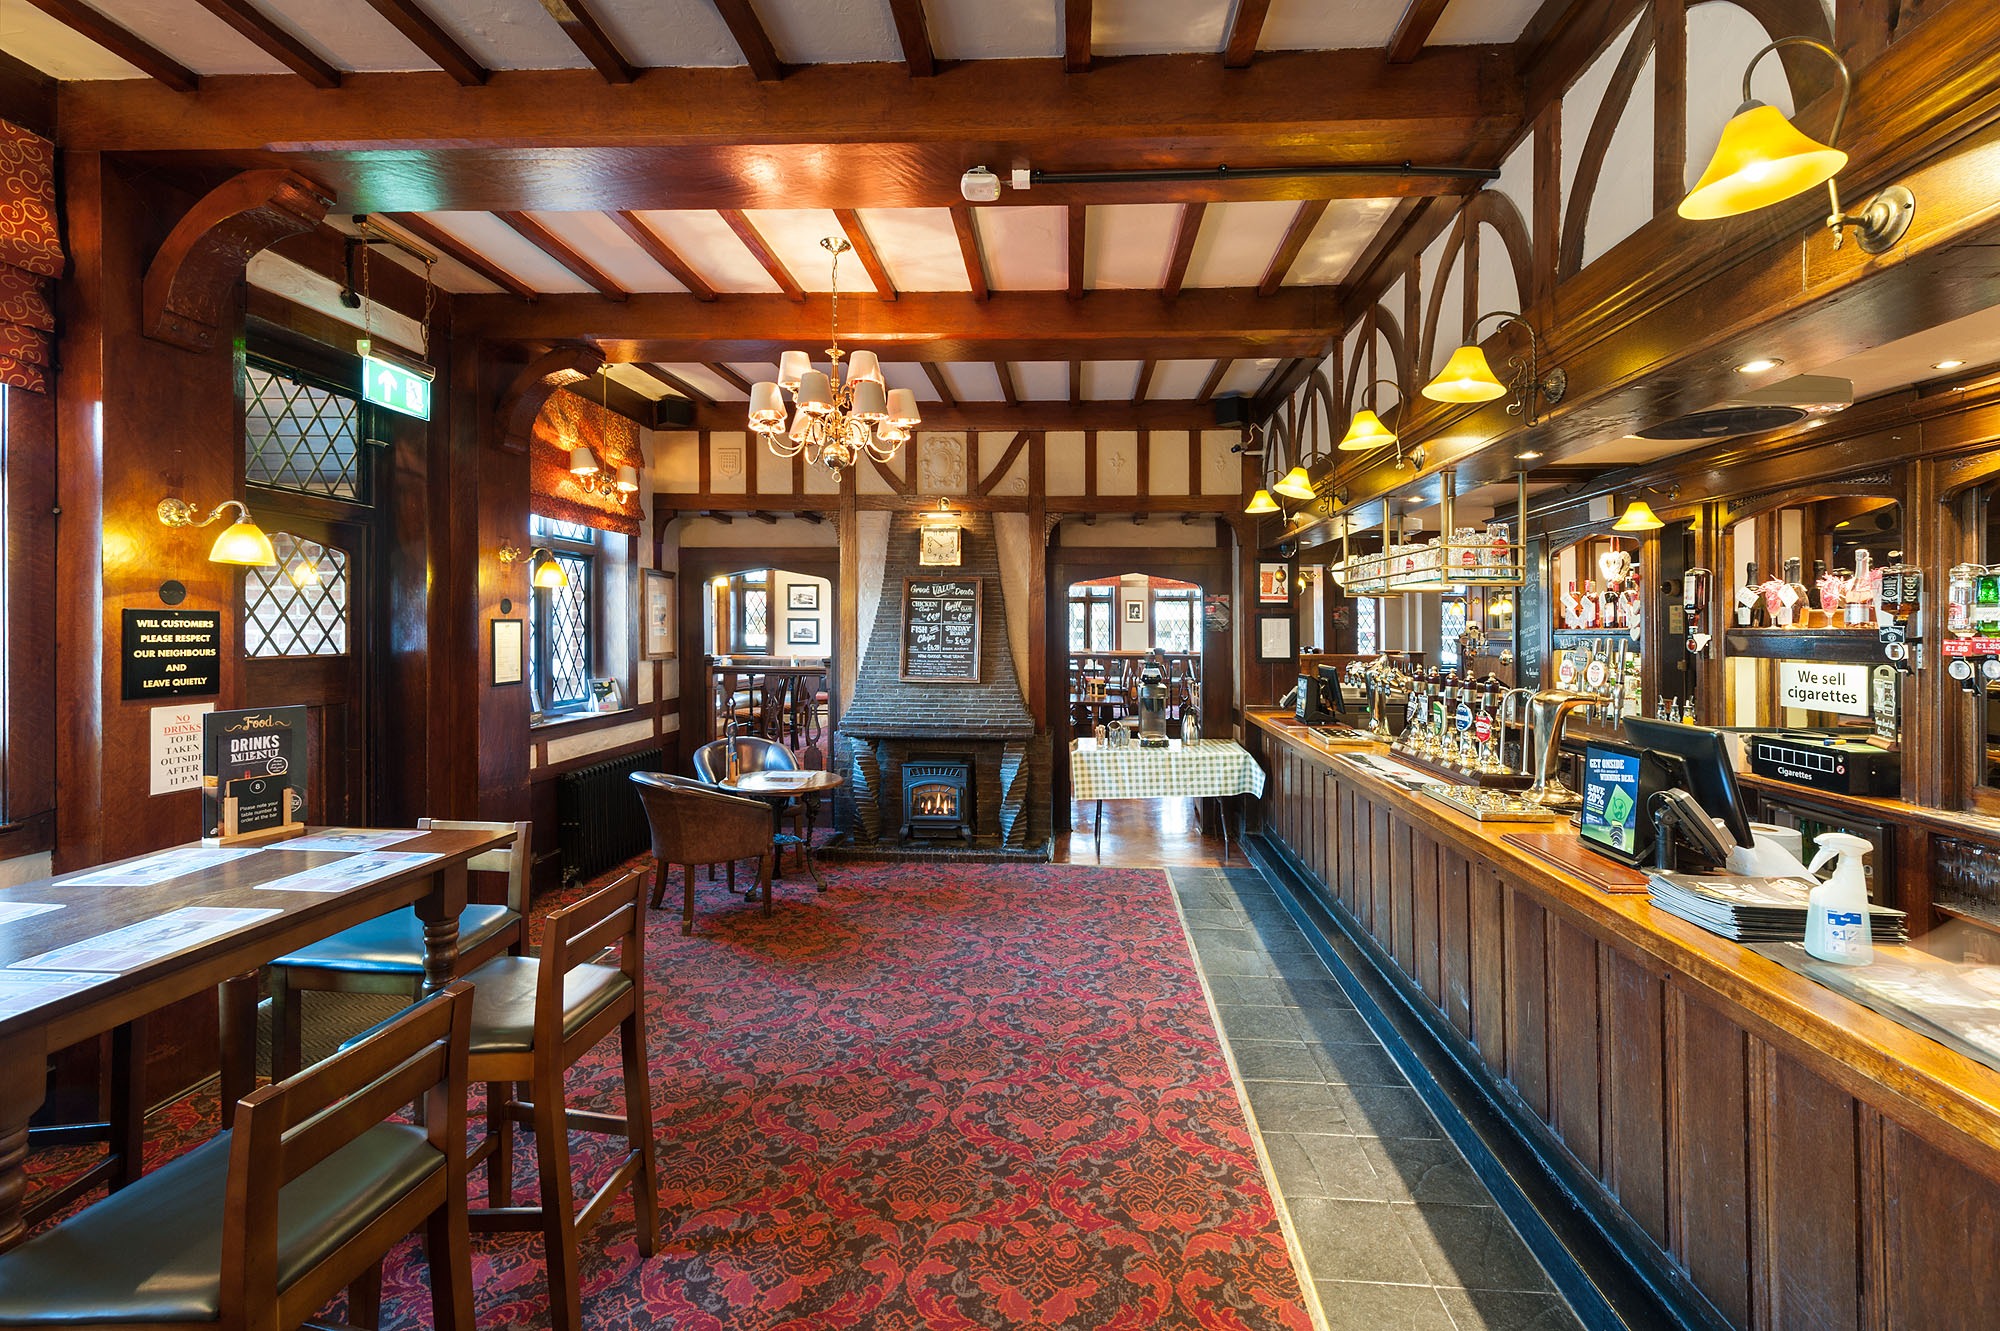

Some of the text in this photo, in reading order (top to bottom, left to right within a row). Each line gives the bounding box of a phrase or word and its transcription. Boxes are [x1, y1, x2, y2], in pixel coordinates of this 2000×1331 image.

[932, 583, 956, 595] VALUE
[161, 620, 214, 628] CUSTOMERS
[917, 634, 936, 643] Chips
[158, 649, 216, 658] NEIGHBOURS
[143, 677, 207, 688] LEAVE QUIETLY
[1798, 670, 1845, 685] We sell
[1788, 686, 1857, 704] cigarettes
[242, 714, 275, 731] Food
[164, 724, 201, 734] DRINKS
[165, 744, 200, 754] TAKEN
[231, 735, 280, 753] DRINKS
[230, 748, 279, 763] MENU
[1590, 759, 1601, 768] GET
[166, 764, 199, 776] AFTER
[1778, 766, 1812, 780] Cigarettes
[1587, 784, 1605, 795] SAVE
[1587, 792, 1604, 805] 20%
